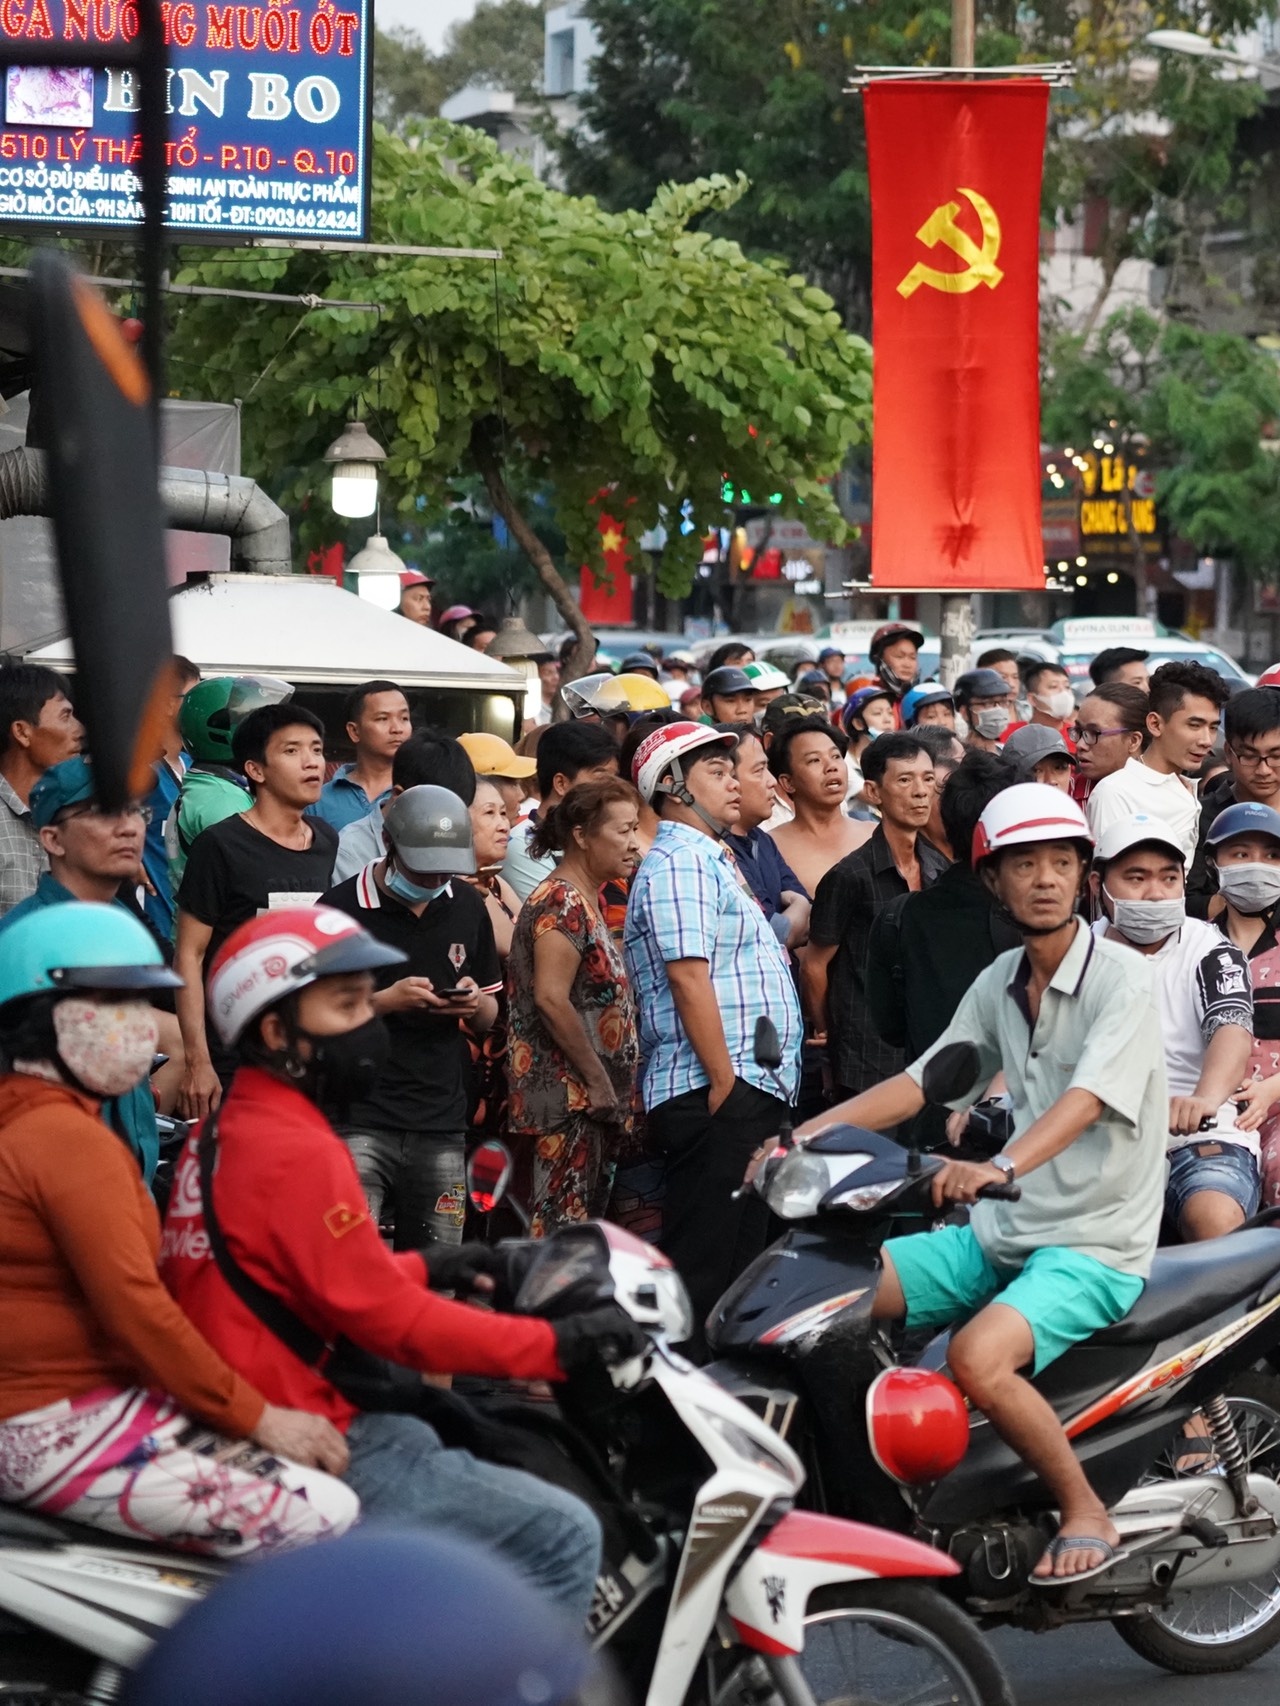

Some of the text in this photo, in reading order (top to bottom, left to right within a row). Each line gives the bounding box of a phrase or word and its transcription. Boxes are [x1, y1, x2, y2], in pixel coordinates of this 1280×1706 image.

[248, 73, 342, 124] BO
[1, 133, 48, 160] 510
[57, 129, 86, 162] LÝ
[93, 132, 143, 165] THÁ
[220, 144, 271, 171] P.10
[293, 148, 355, 175] Q.10
